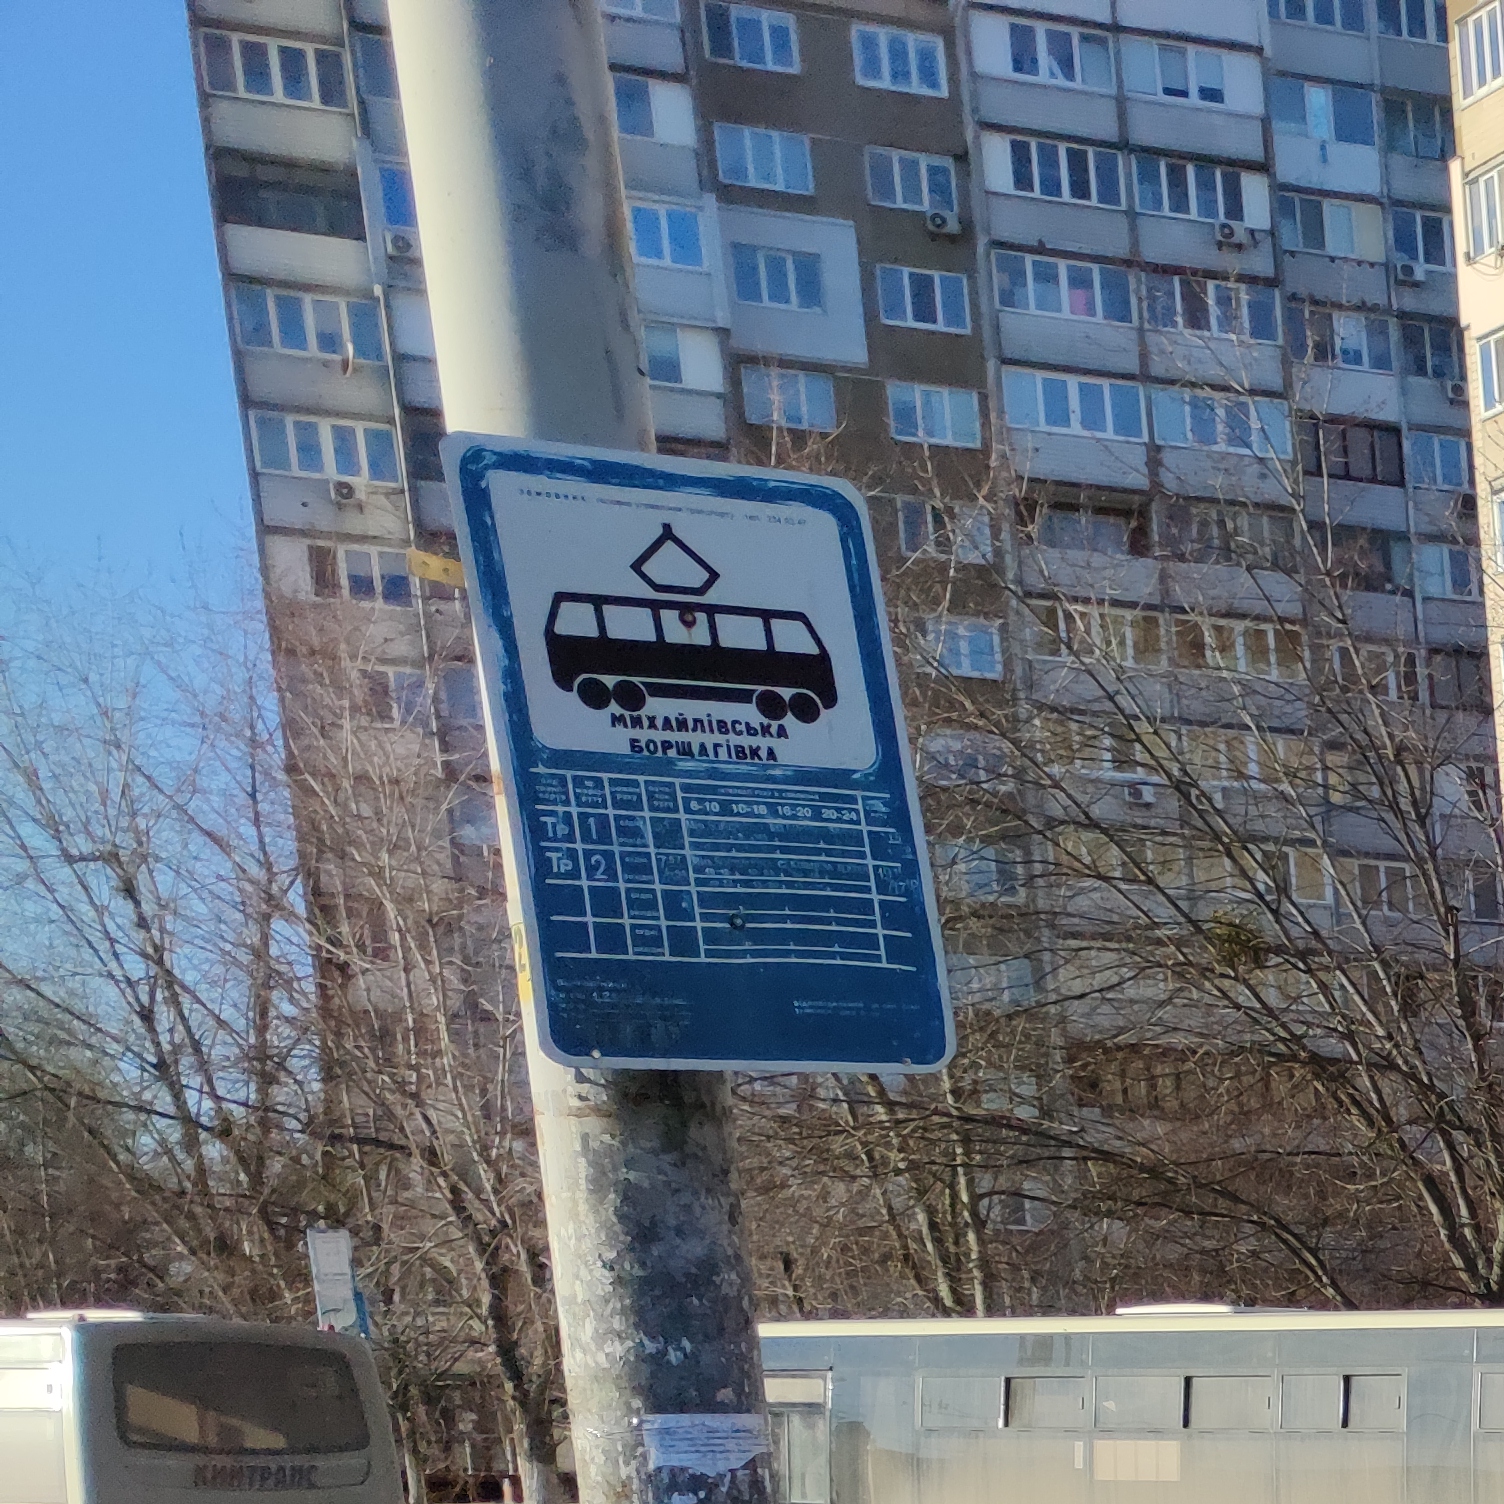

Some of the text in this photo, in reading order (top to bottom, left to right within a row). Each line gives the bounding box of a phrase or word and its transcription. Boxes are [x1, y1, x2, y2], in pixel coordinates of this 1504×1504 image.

[610, 712, 790, 740] МИХАЙЛІВСЬКА
[629, 738, 779, 763] БОРЩАГІВКА
[689, 801, 721, 813] 6-10
[821, 808, 858, 821] 20-24
[587, 816, 597, 840] 1
[590, 854, 609, 880] 2
